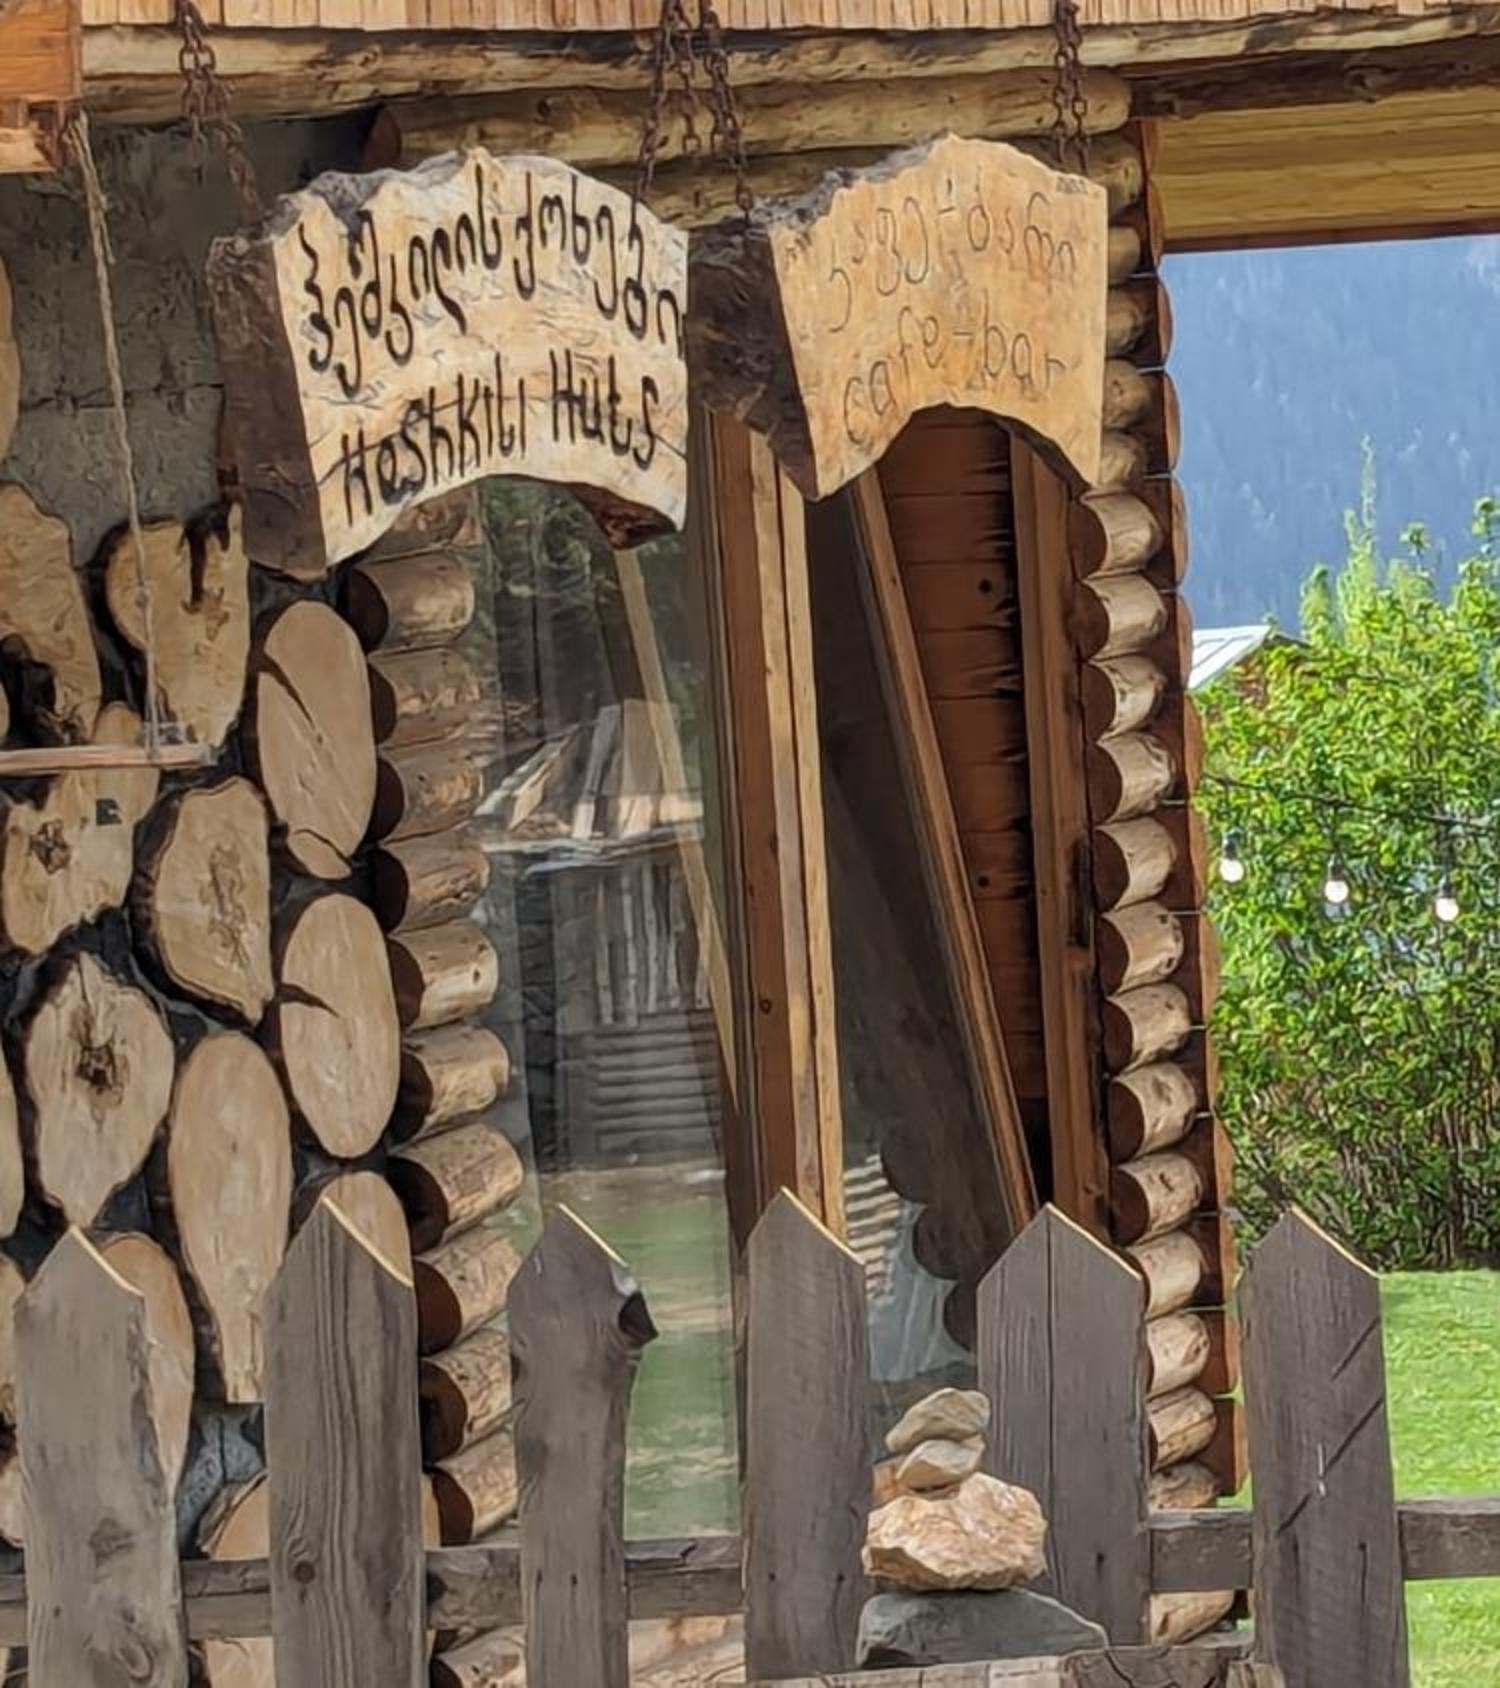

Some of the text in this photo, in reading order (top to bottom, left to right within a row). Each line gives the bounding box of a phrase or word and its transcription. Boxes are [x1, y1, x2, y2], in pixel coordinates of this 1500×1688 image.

[300, 164, 687, 398] ჰეშკილის ქოხები
[550, 349, 660, 470] Huts
